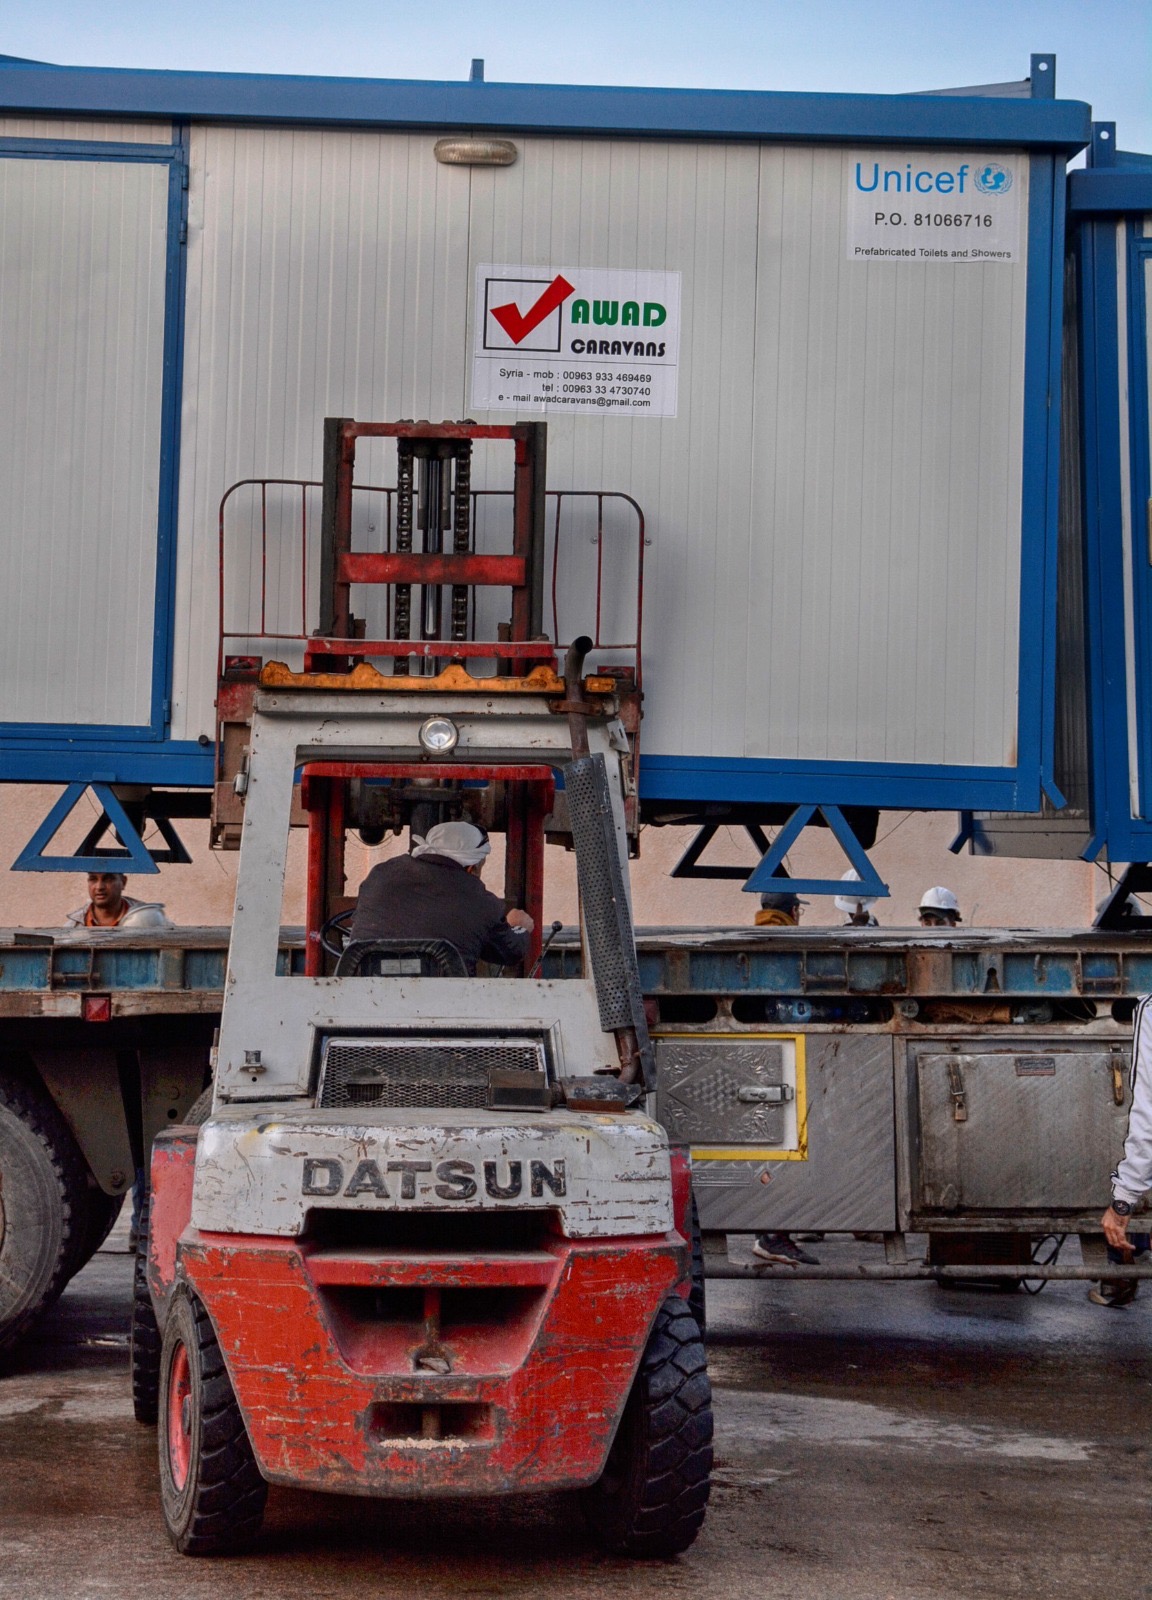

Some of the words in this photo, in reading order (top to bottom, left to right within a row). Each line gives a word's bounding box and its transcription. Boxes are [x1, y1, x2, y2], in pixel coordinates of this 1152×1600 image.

[856, 163, 969, 193] Unicef
[875, 213, 907, 225] P.O.
[914, 214, 992, 227] 81066716
[854, 247, 915, 256] Prefabricated
[919, 248, 948, 257] Toilets
[971, 249, 1011, 258] Showers
[571, 299, 667, 327] AWAD
[571, 339, 666, 357] CARAVANS
[499, 368, 523, 380] Syria
[533, 371, 554, 379] mob
[563, 372, 592, 380] 00963
[596, 373, 613, 381] 933
[616, 373, 651, 383] 469469
[542, 384, 553, 392] tel
[563, 384, 592, 393] 00963
[595, 386, 607, 394] 33
[610, 386, 651, 395] 4730740
[513, 394, 531, 402] mail
[534, 395, 651, 407] awadcaravans@gmail.com
[301, 1158, 566, 1199] DATSUN
